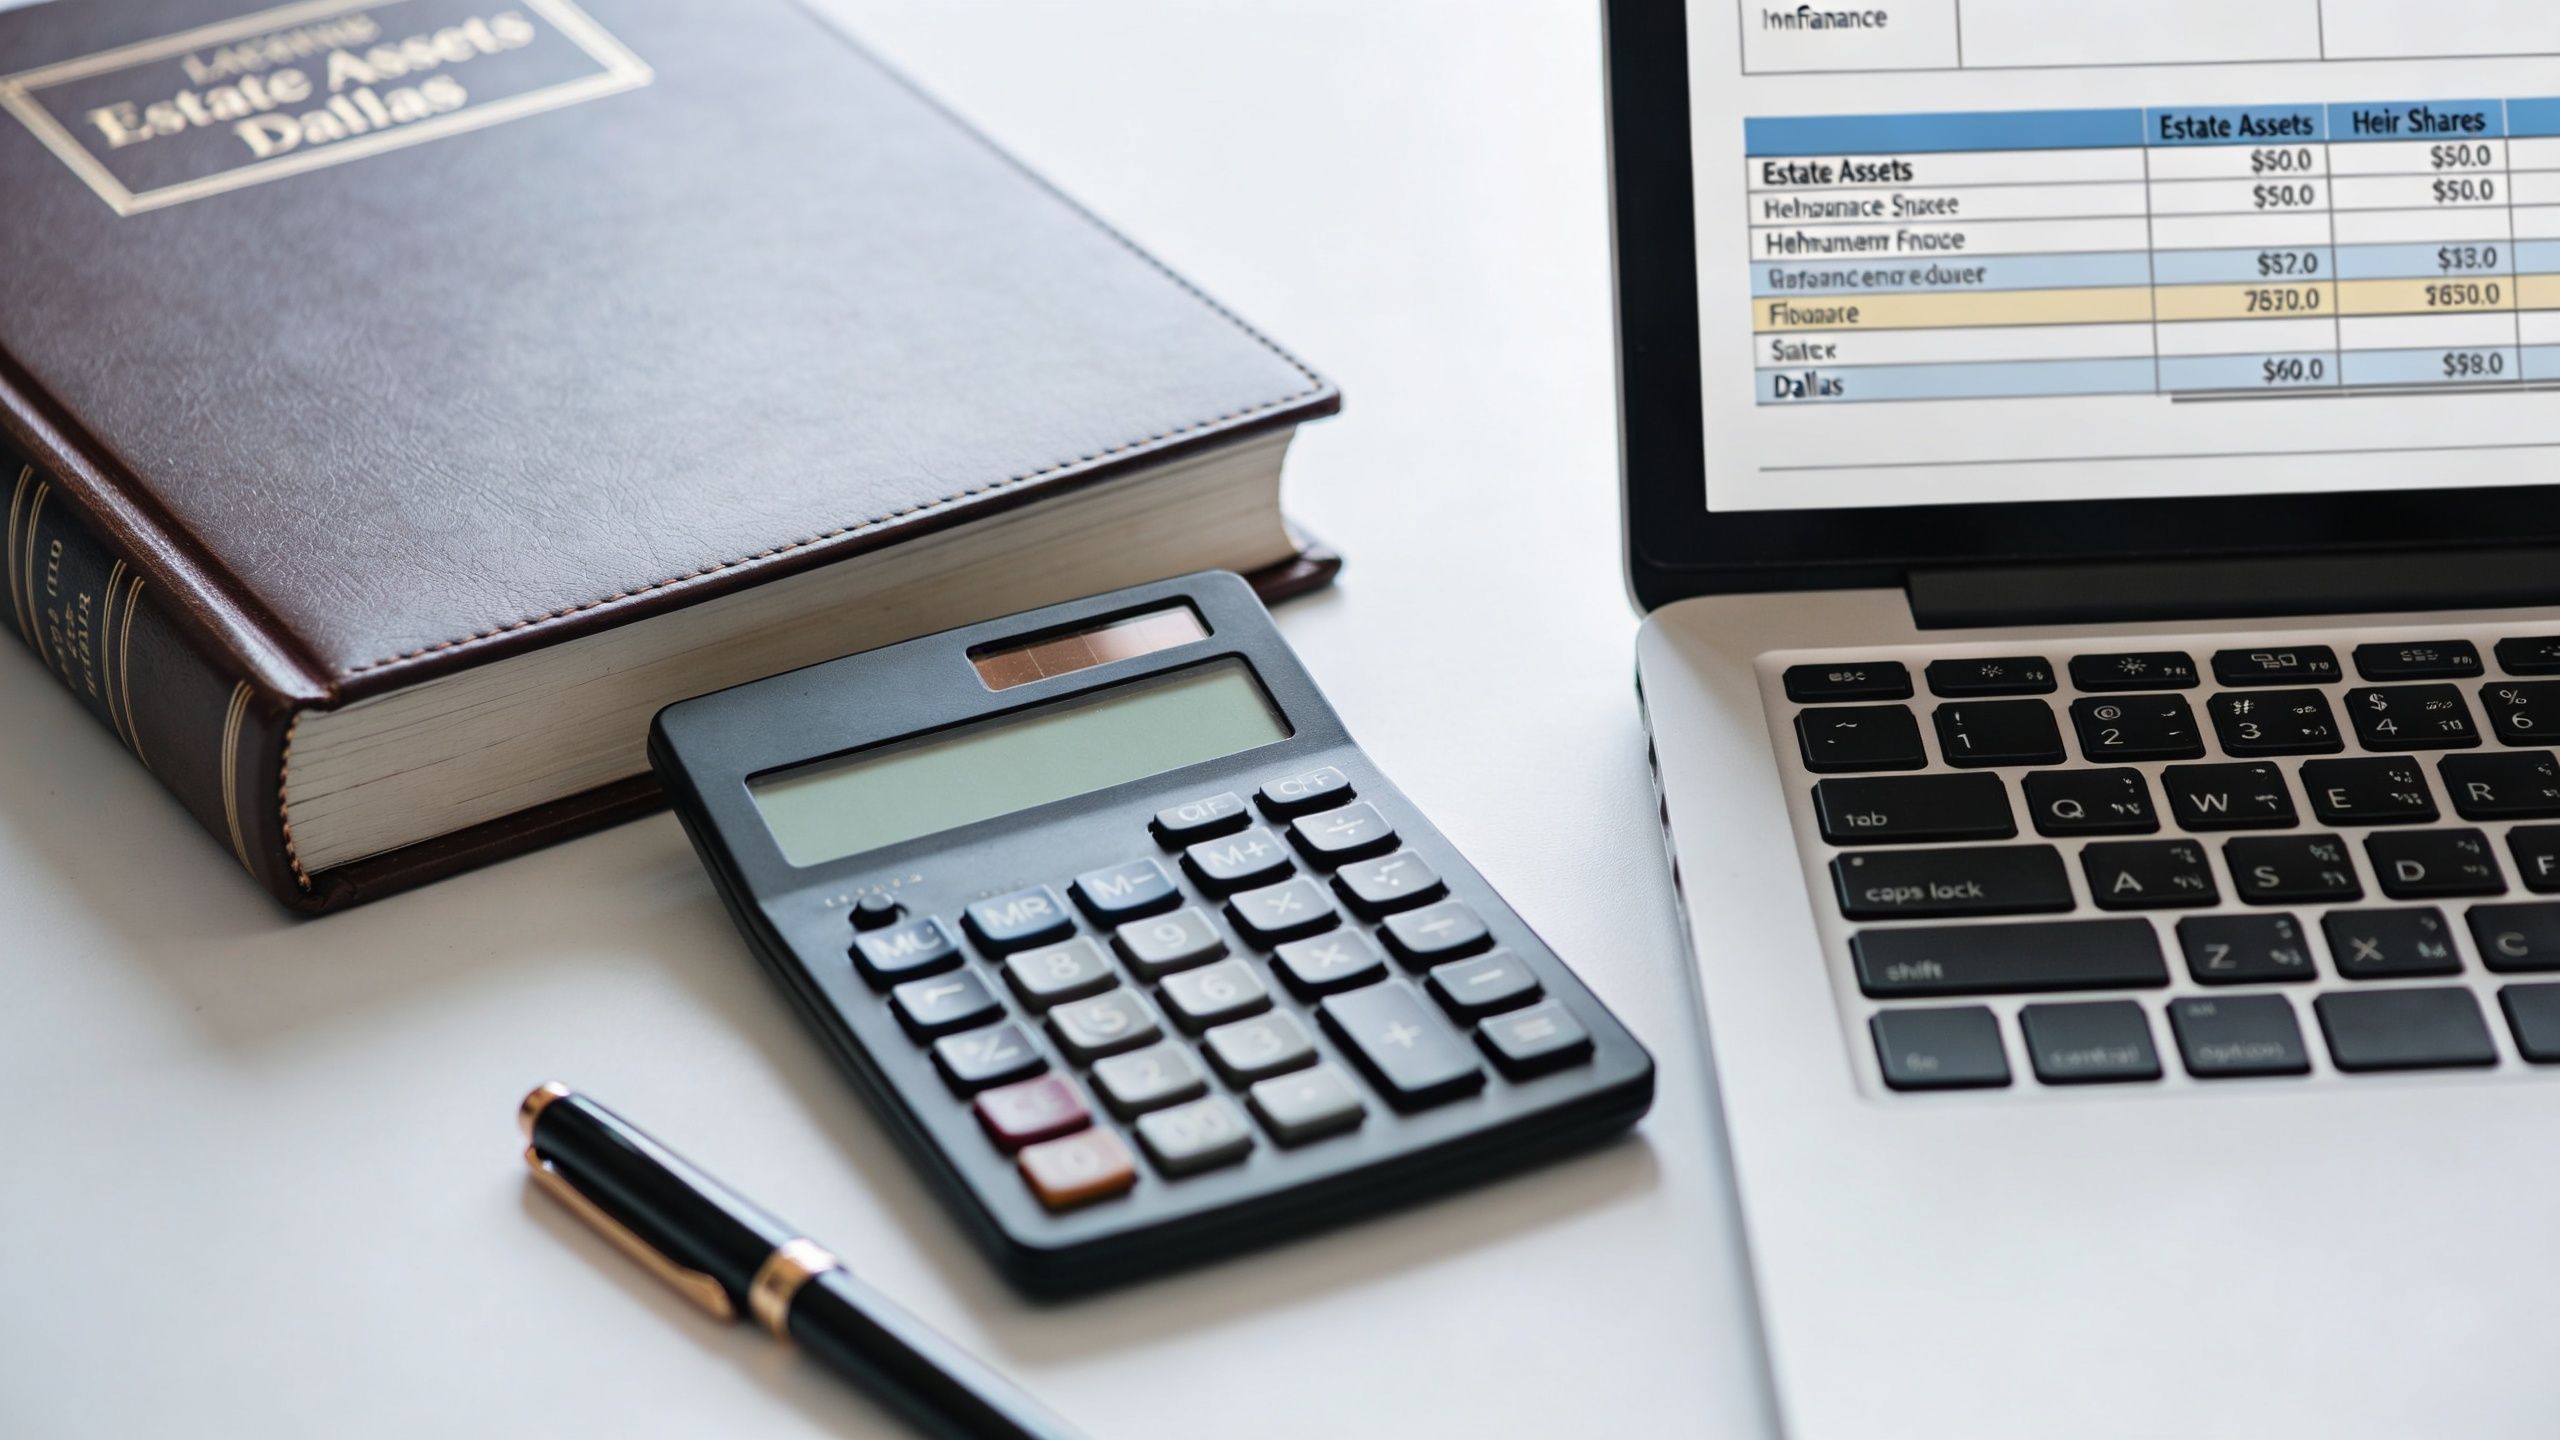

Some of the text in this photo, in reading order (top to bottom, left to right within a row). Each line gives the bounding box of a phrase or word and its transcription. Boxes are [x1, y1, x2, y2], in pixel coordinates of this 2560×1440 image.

[88, 69, 312, 148] Estate
[328, 13, 534, 91] Assets
[234, 75, 467, 157] Dallas
[2159, 113, 2314, 140] Estate Assets
[2352, 105, 2487, 135] Heir Shares
[2250, 149, 2312, 174] $50.0
[2430, 144, 2493, 170] $50.0
[1763, 158, 1913, 185] Estate Assets
[2253, 184, 2316, 209] $50.0
[2432, 179, 2496, 204] $50.0
[2262, 358, 2324, 384] $60.0
[1773, 372, 1844, 399] Dallas
[2239, 722, 2262, 740] 3
[2376, 718, 2398, 735] 4
[2511, 712, 2534, 729] 6
[2100, 728, 2124, 745] 2
[2189, 792, 2228, 813] W
[2327, 788, 2352, 809] E
[2466, 782, 2495, 802] R
[1845, 811, 1888, 827] tab
[2051, 799, 2085, 819] Q
[2253, 866, 2280, 888] S
[2395, 860, 2426, 882] D
[2536, 855, 2554, 876] F
[1865, 881, 1983, 905] caps lock
[2113, 871, 2143, 894] A
[984, 897, 1051, 929] MR
[1151, 922, 1188, 949] 9
[2496, 932, 2528, 956] C
[2205, 943, 2237, 969] Z
[2351, 937, 2384, 962] X
[1046, 953, 1080, 979] 8
[1886, 960, 1943, 982] shift
[1202, 973, 1236, 999] 6
[1090, 1005, 1128, 1034] 5
[1252, 1025, 1282, 1049] 3
